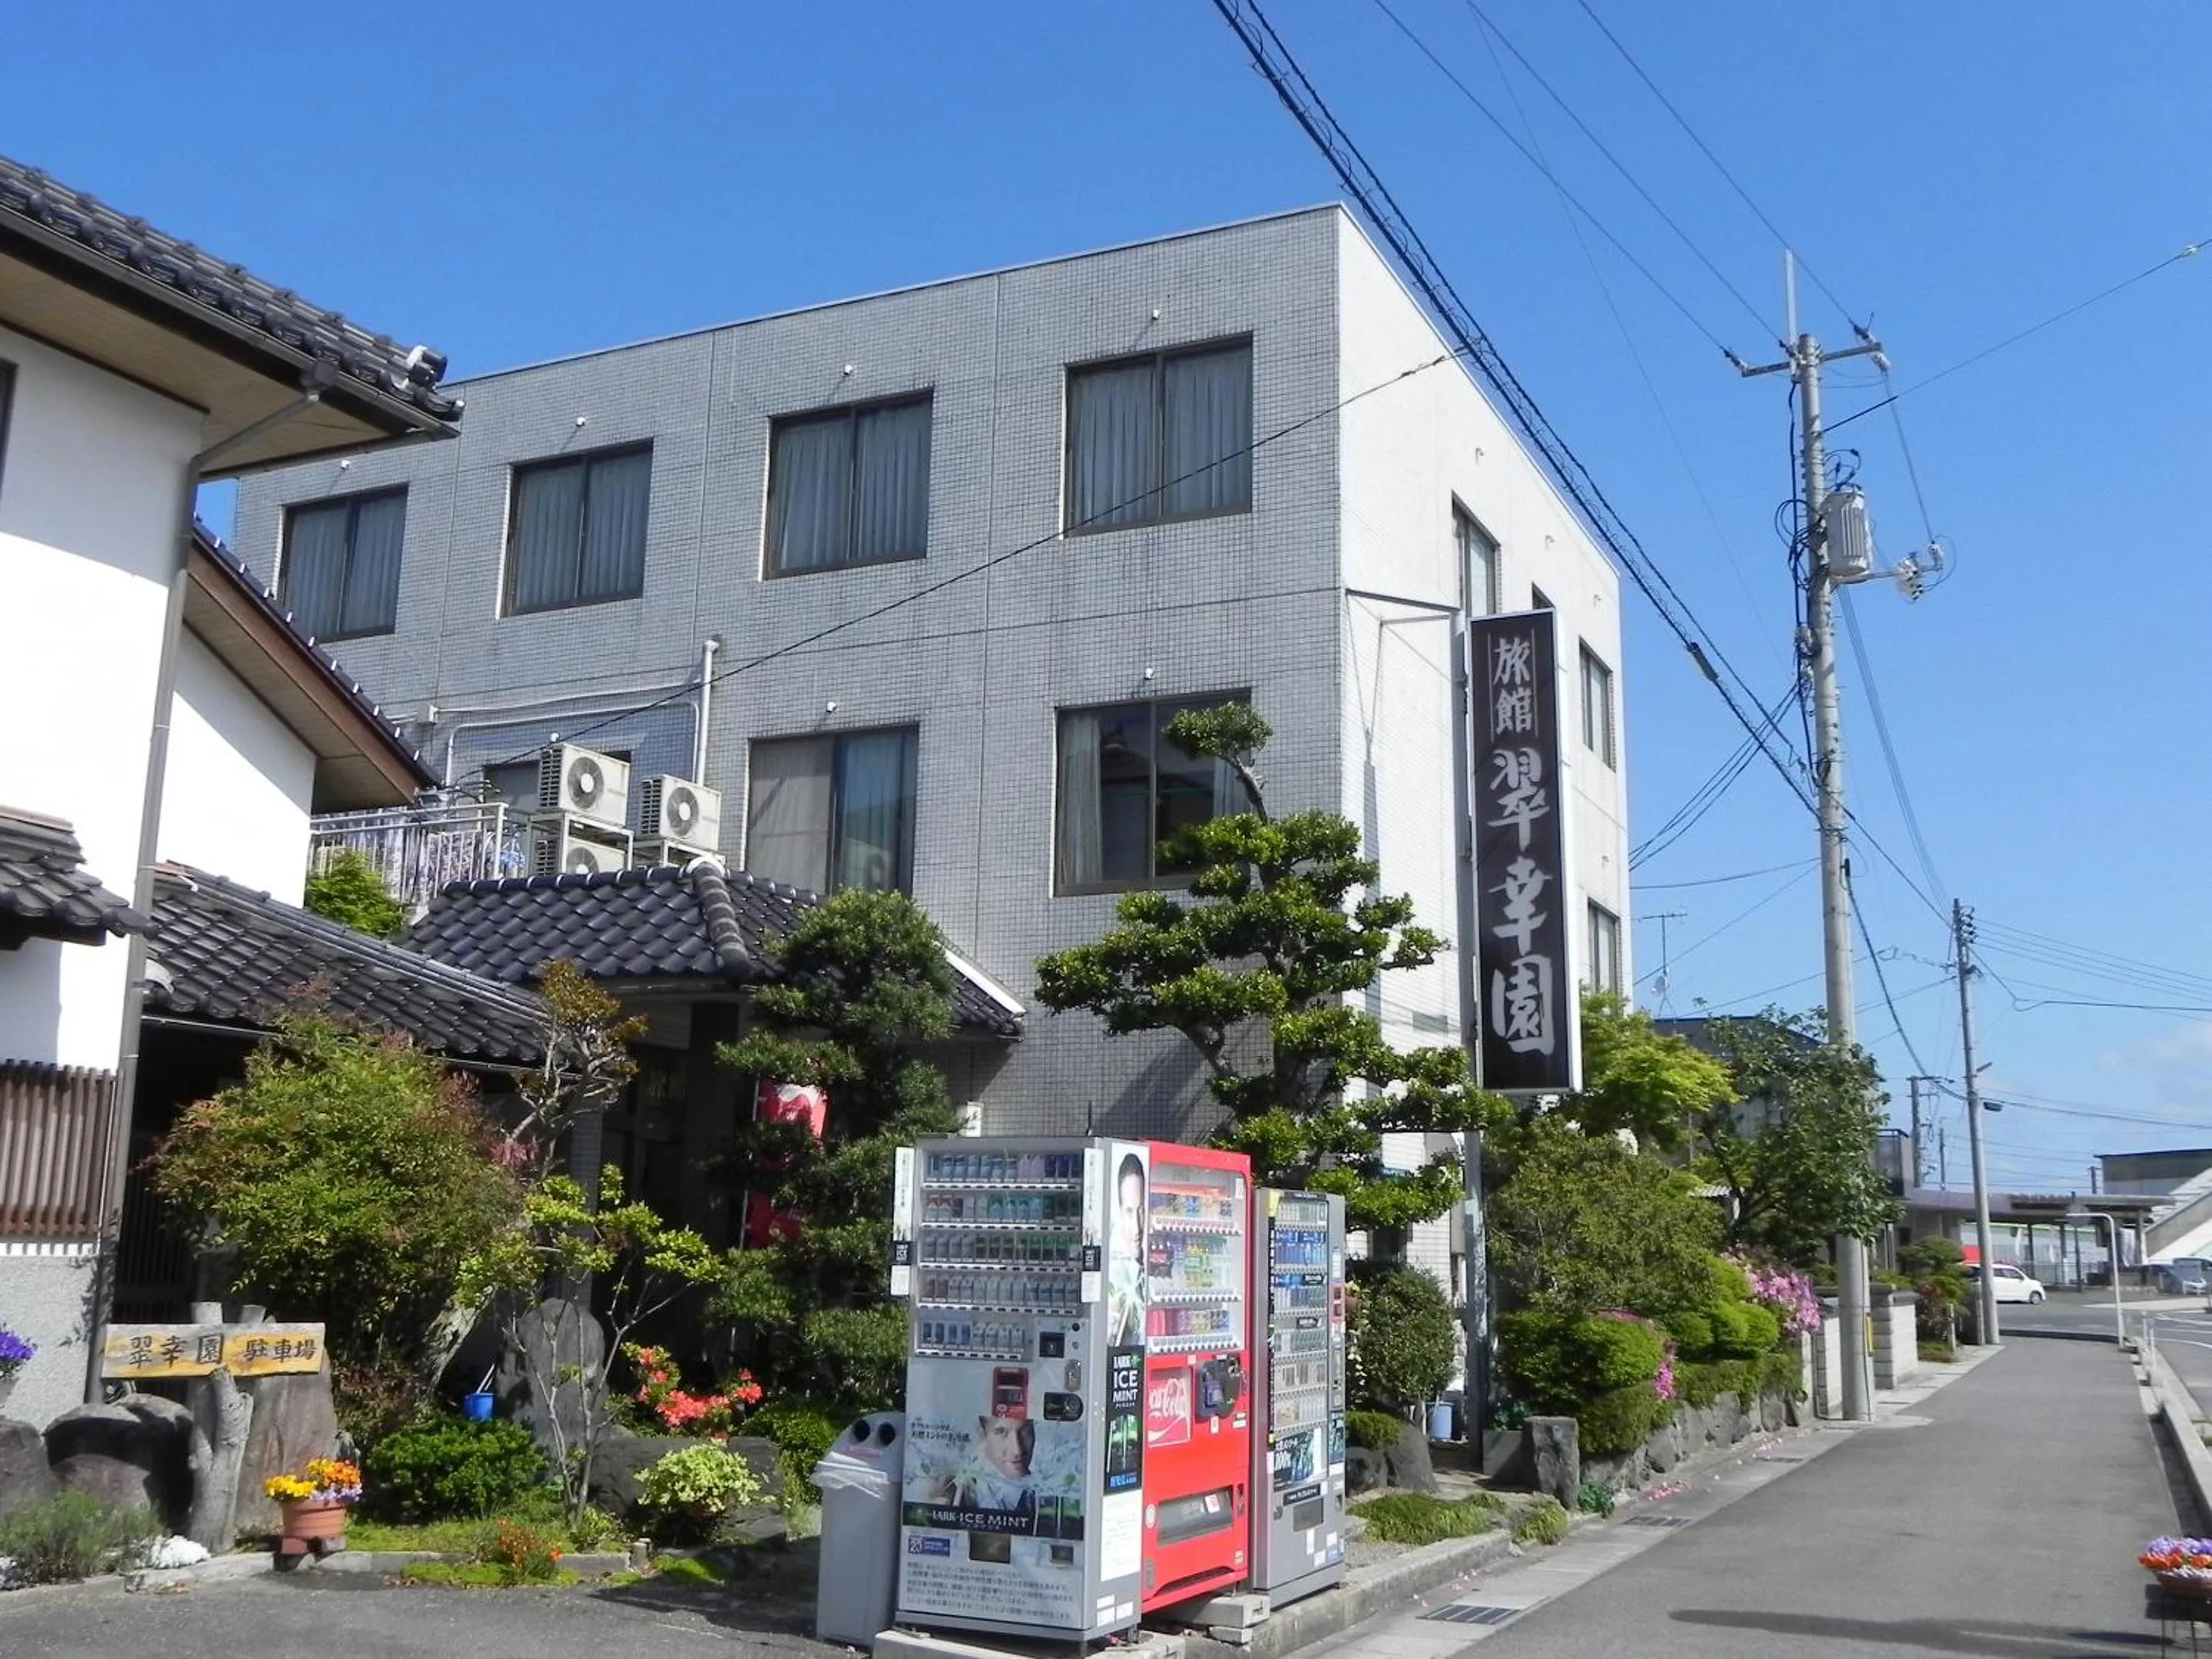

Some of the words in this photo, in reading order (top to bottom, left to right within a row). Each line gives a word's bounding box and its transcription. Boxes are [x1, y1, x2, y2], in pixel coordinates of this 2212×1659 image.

[1493, 637, 1532, 735] 旅館
[129, 1333, 224, 1369] 翠幸園
[243, 1339, 317, 1363] 駐車場
[1114, 1370, 1137, 1389] ICE
[1113, 1389, 1138, 1403] MINT
[959, 1512, 984, 1524] ICE
[987, 1515, 1029, 1528] MINT
